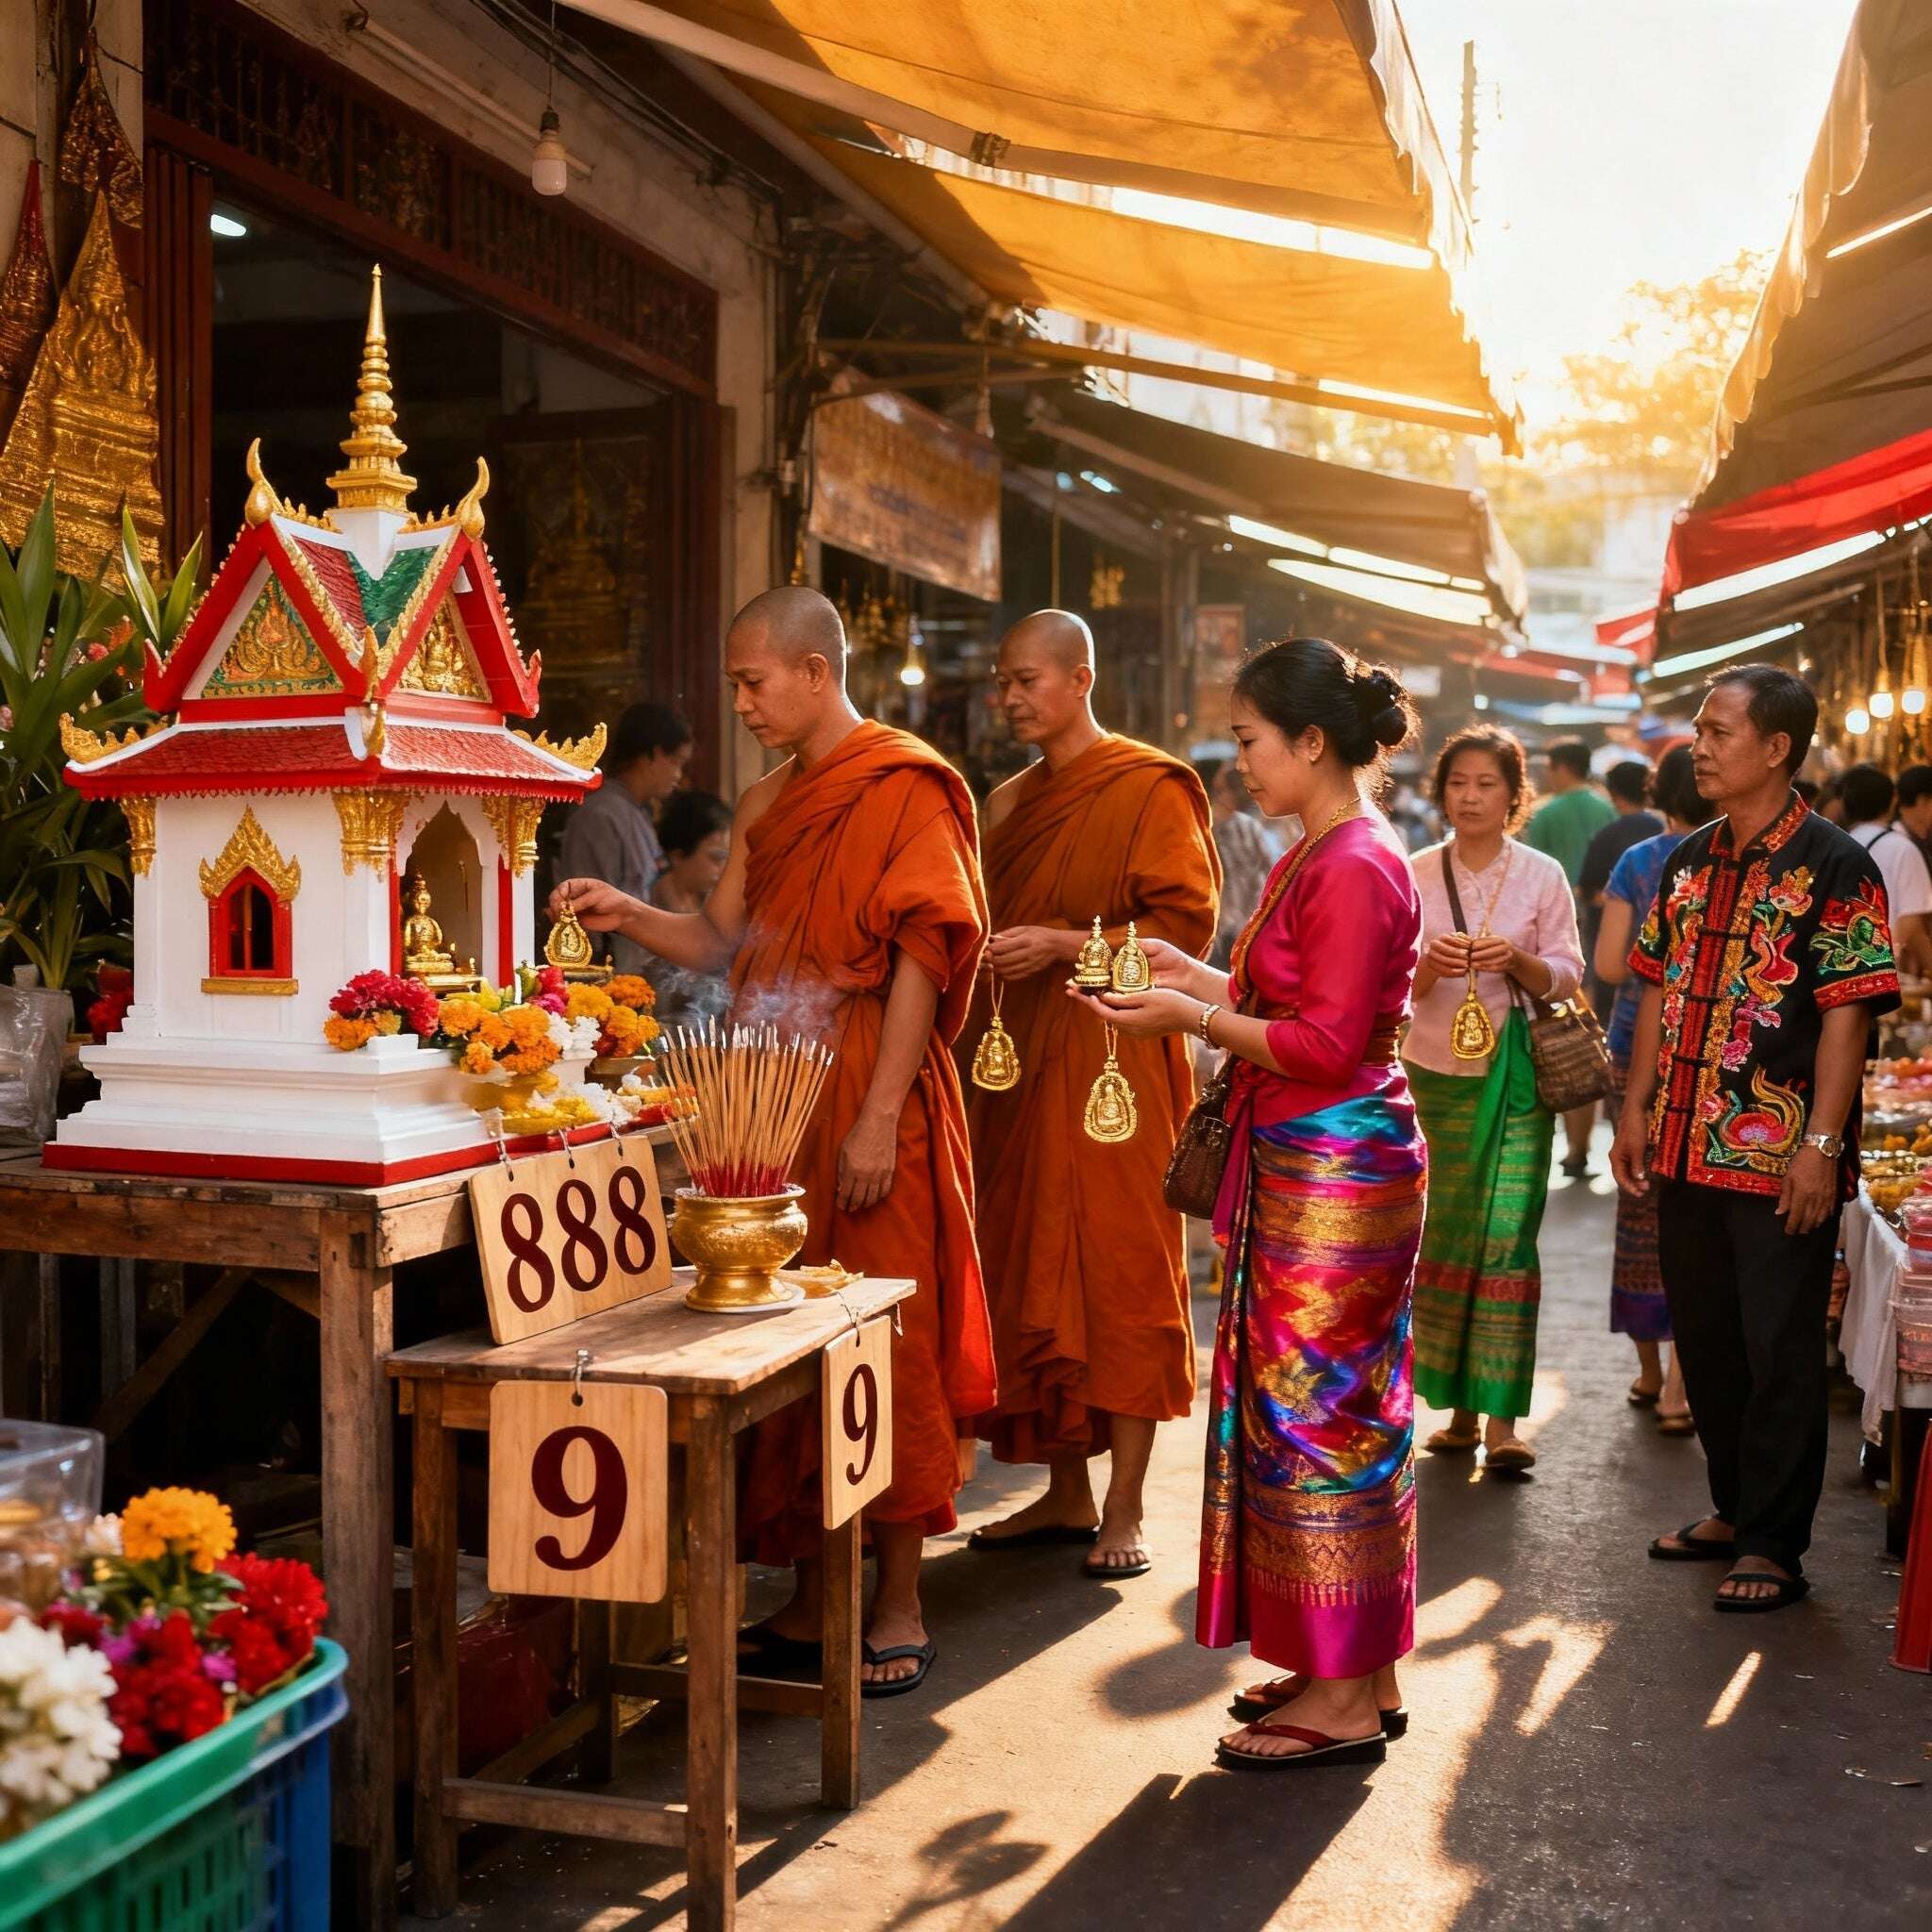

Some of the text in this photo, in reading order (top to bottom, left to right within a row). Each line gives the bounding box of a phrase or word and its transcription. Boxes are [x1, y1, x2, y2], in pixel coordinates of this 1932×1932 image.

[500, 1165, 657, 1312] 888
[842, 1363, 878, 1486] 9
[531, 1425, 627, 1572] 9
